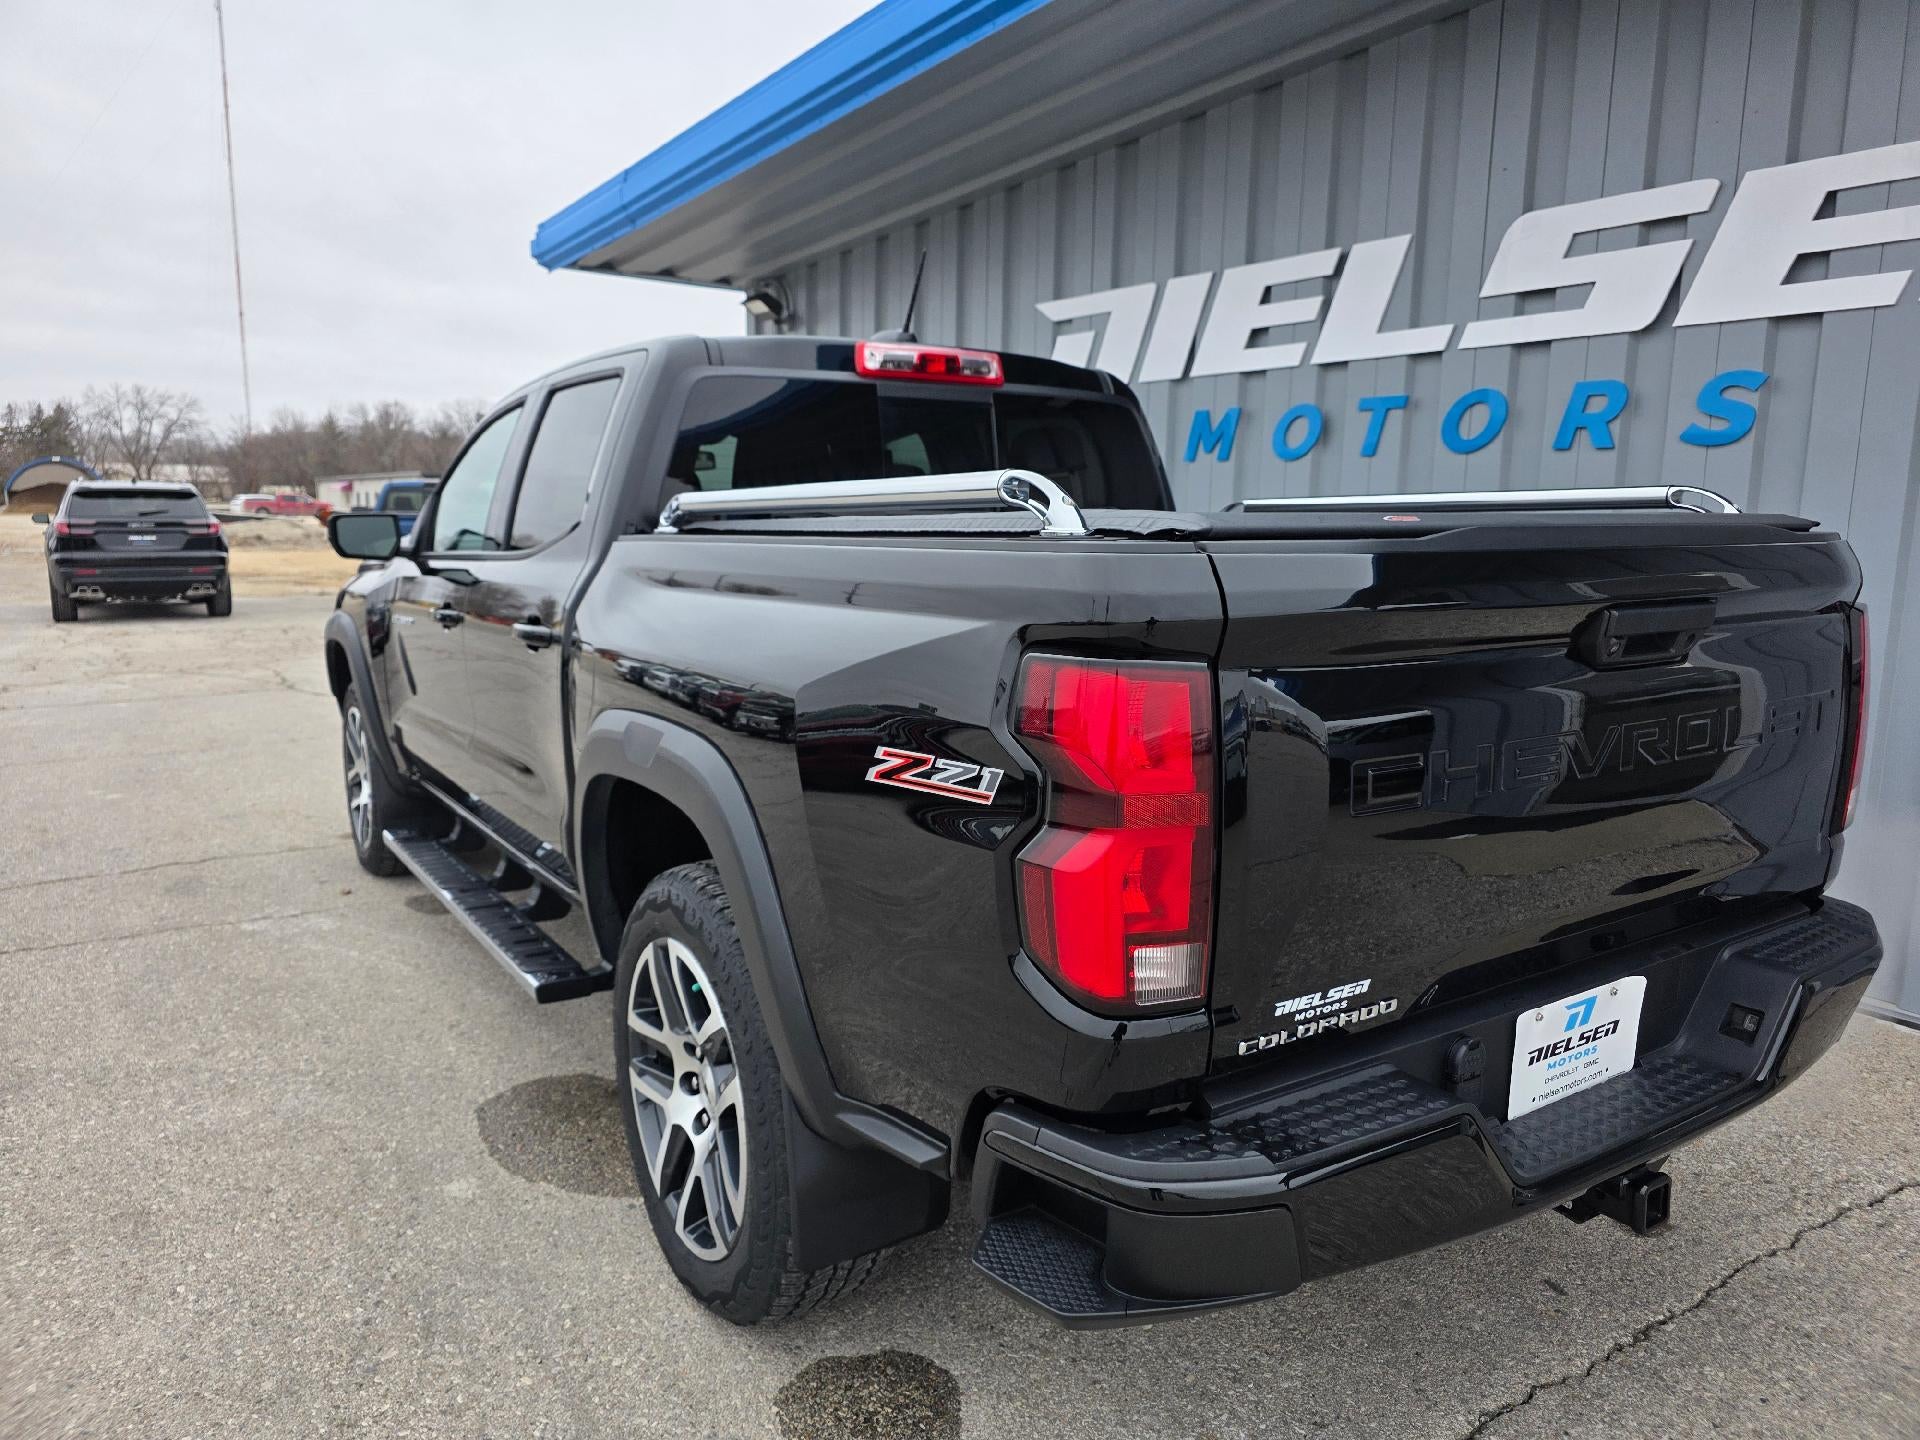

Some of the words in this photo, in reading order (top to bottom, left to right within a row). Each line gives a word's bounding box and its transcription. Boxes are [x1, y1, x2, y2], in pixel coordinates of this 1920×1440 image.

[1034, 141, 1920, 385] NIELSE
[1185, 369, 1771, 464] MOTORS
[864, 745, 1005, 806] Z71
[1351, 690, 1834, 818] CHEVROLET
[1274, 979, 1372, 1017] NIELSEN
[1294, 1000, 1348, 1022] MOTORS
[1238, 998, 1398, 1056] COLORADO
[1527, 1019, 1620, 1067] NIELSEN
[1544, 1066, 1580, 1085] CHEVROLET
[1583, 1057, 1600, 1069] GMC
[1546, 1045, 1598, 1071] MOTORS
[1538, 1070, 1603, 1103] nielsenmotors.com
